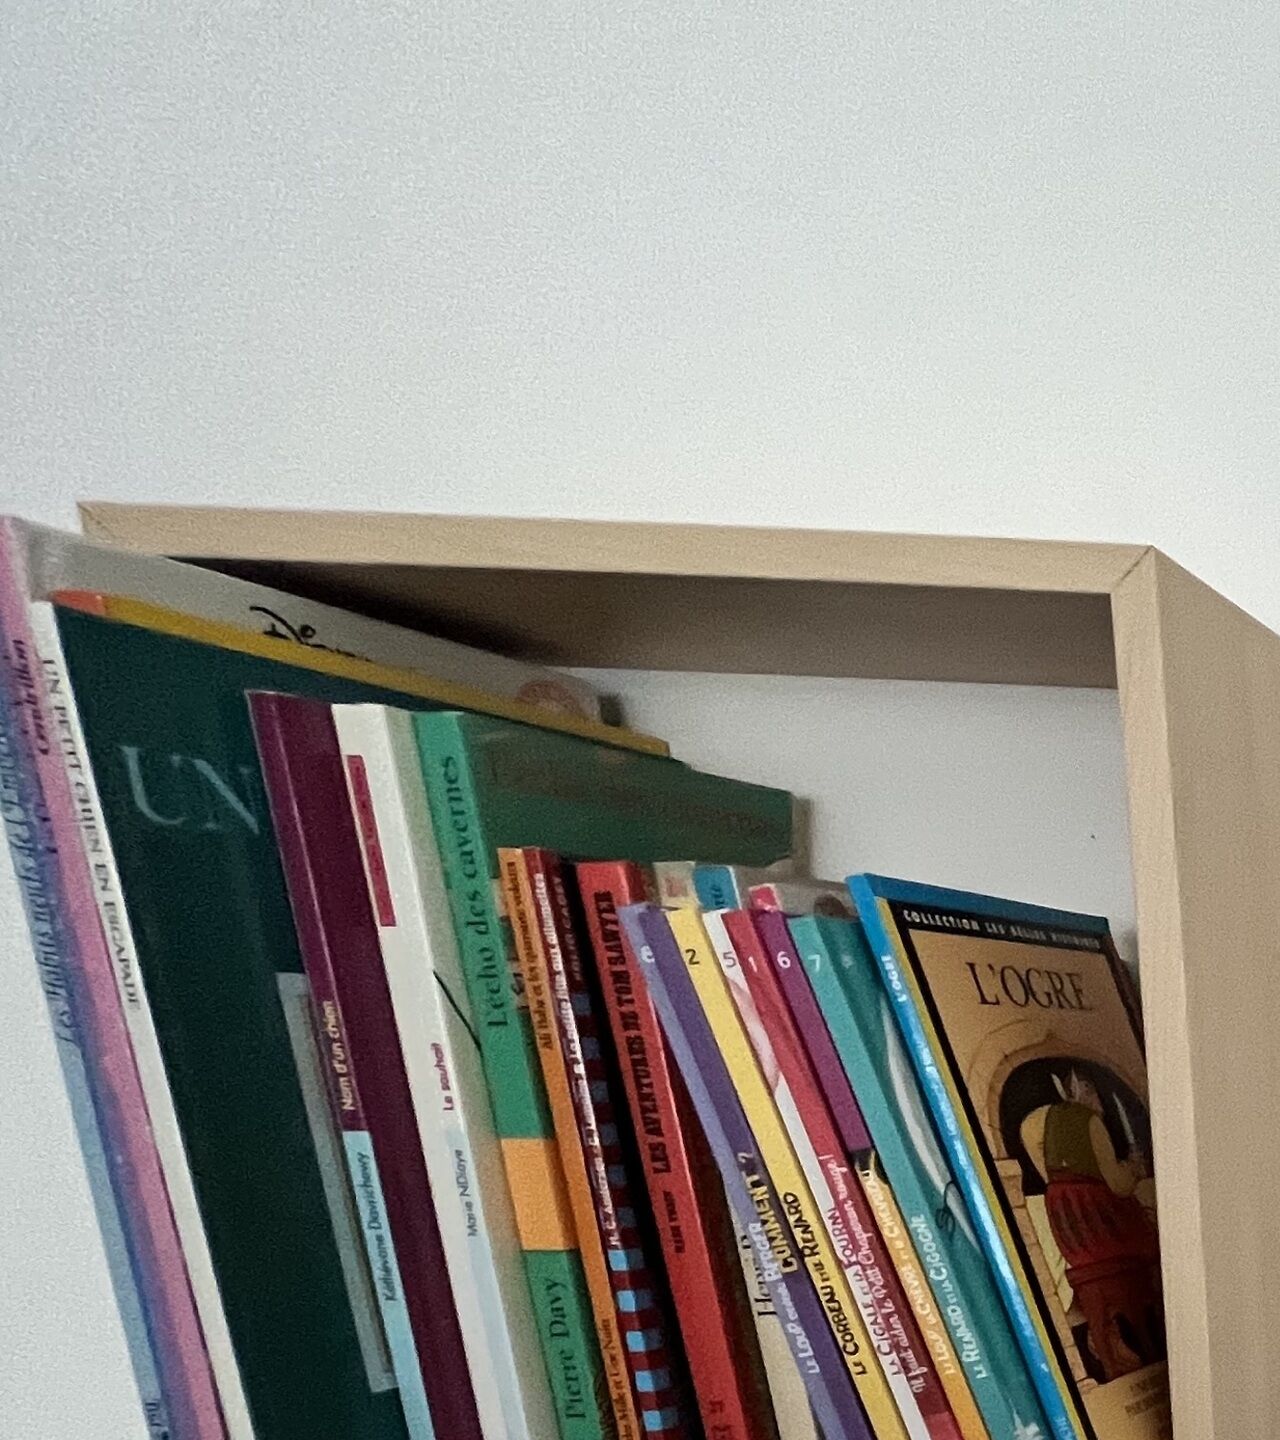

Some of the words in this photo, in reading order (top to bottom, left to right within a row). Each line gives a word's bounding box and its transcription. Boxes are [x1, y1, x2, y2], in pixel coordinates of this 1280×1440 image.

[116, 744, 261, 835] UN
[42, 659, 62, 694] UN
[54, 705, 82, 771] PETIT
[75, 781, 103, 852] CHIEN
[94, 862, 112, 892] EN
[104, 901, 141, 1010] ESCAPADE
[441, 756, 479, 878] cavernes
[466, 890, 489, 935] des
[534, 873, 558, 945] allumettes
[594, 889, 626, 967] SAWYER
[902, 909, 981, 931] COLLECTION
[985, 921, 1006, 936] LES
[685, 948, 701, 966] 2
[722, 951, 738, 969] 5
[747, 955, 759, 973] 1
[776, 950, 792, 969] 6
[807, 954, 822, 973] 7
[610, 969, 634, 1005] TOM
[880, 954, 908, 1003] L'OGRE
[965, 961, 1095, 1012] L'OGRE
[322, 1001, 342, 1038] chien
[620, 1009, 638, 1034] DE
[333, 1041, 351, 1074] d'un
[431, 1042, 451, 1090] souhait
[340, 1079, 355, 1110] Nom
[443, 1096, 455, 1111] Le
[626, 1033, 664, 1137] AVENTURES
[453, 1150, 471, 1196] NDiaye
[651, 1138, 672, 1174] LES
[737, 1151, 754, 1165] ?
[460, 1202, 477, 1236] Marie
[746, 1172, 799, 1274] COMMENT
[783, 1191, 820, 1259] RENARD
[826, 1206, 860, 1270] FOURMI
[844, 1200, 878, 1266] Chaperon
[750, 1222, 783, 1282] BERGER
[910, 1214, 949, 1282] CIGOGNE
[865, 1266, 890, 1299] Petit
[544, 1277, 570, 1338] Davy
[820, 1284, 861, 1357] CORBEAU
[880, 1297, 897, 1316] le
[786, 1320, 814, 1359] LOUP
[863, 1302, 895, 1357] CIGALE
[888, 1317, 912, 1352] aider
[946, 1303, 983, 1362] RENARD
[805, 1361, 821, 1375] LE
[851, 1360, 868, 1377] LE
[889, 1359, 906, 1376] LA
[898, 1350, 929, 1378] faut
[974, 1357, 991, 1379] LE
[559, 1350, 587, 1419] Pierre
